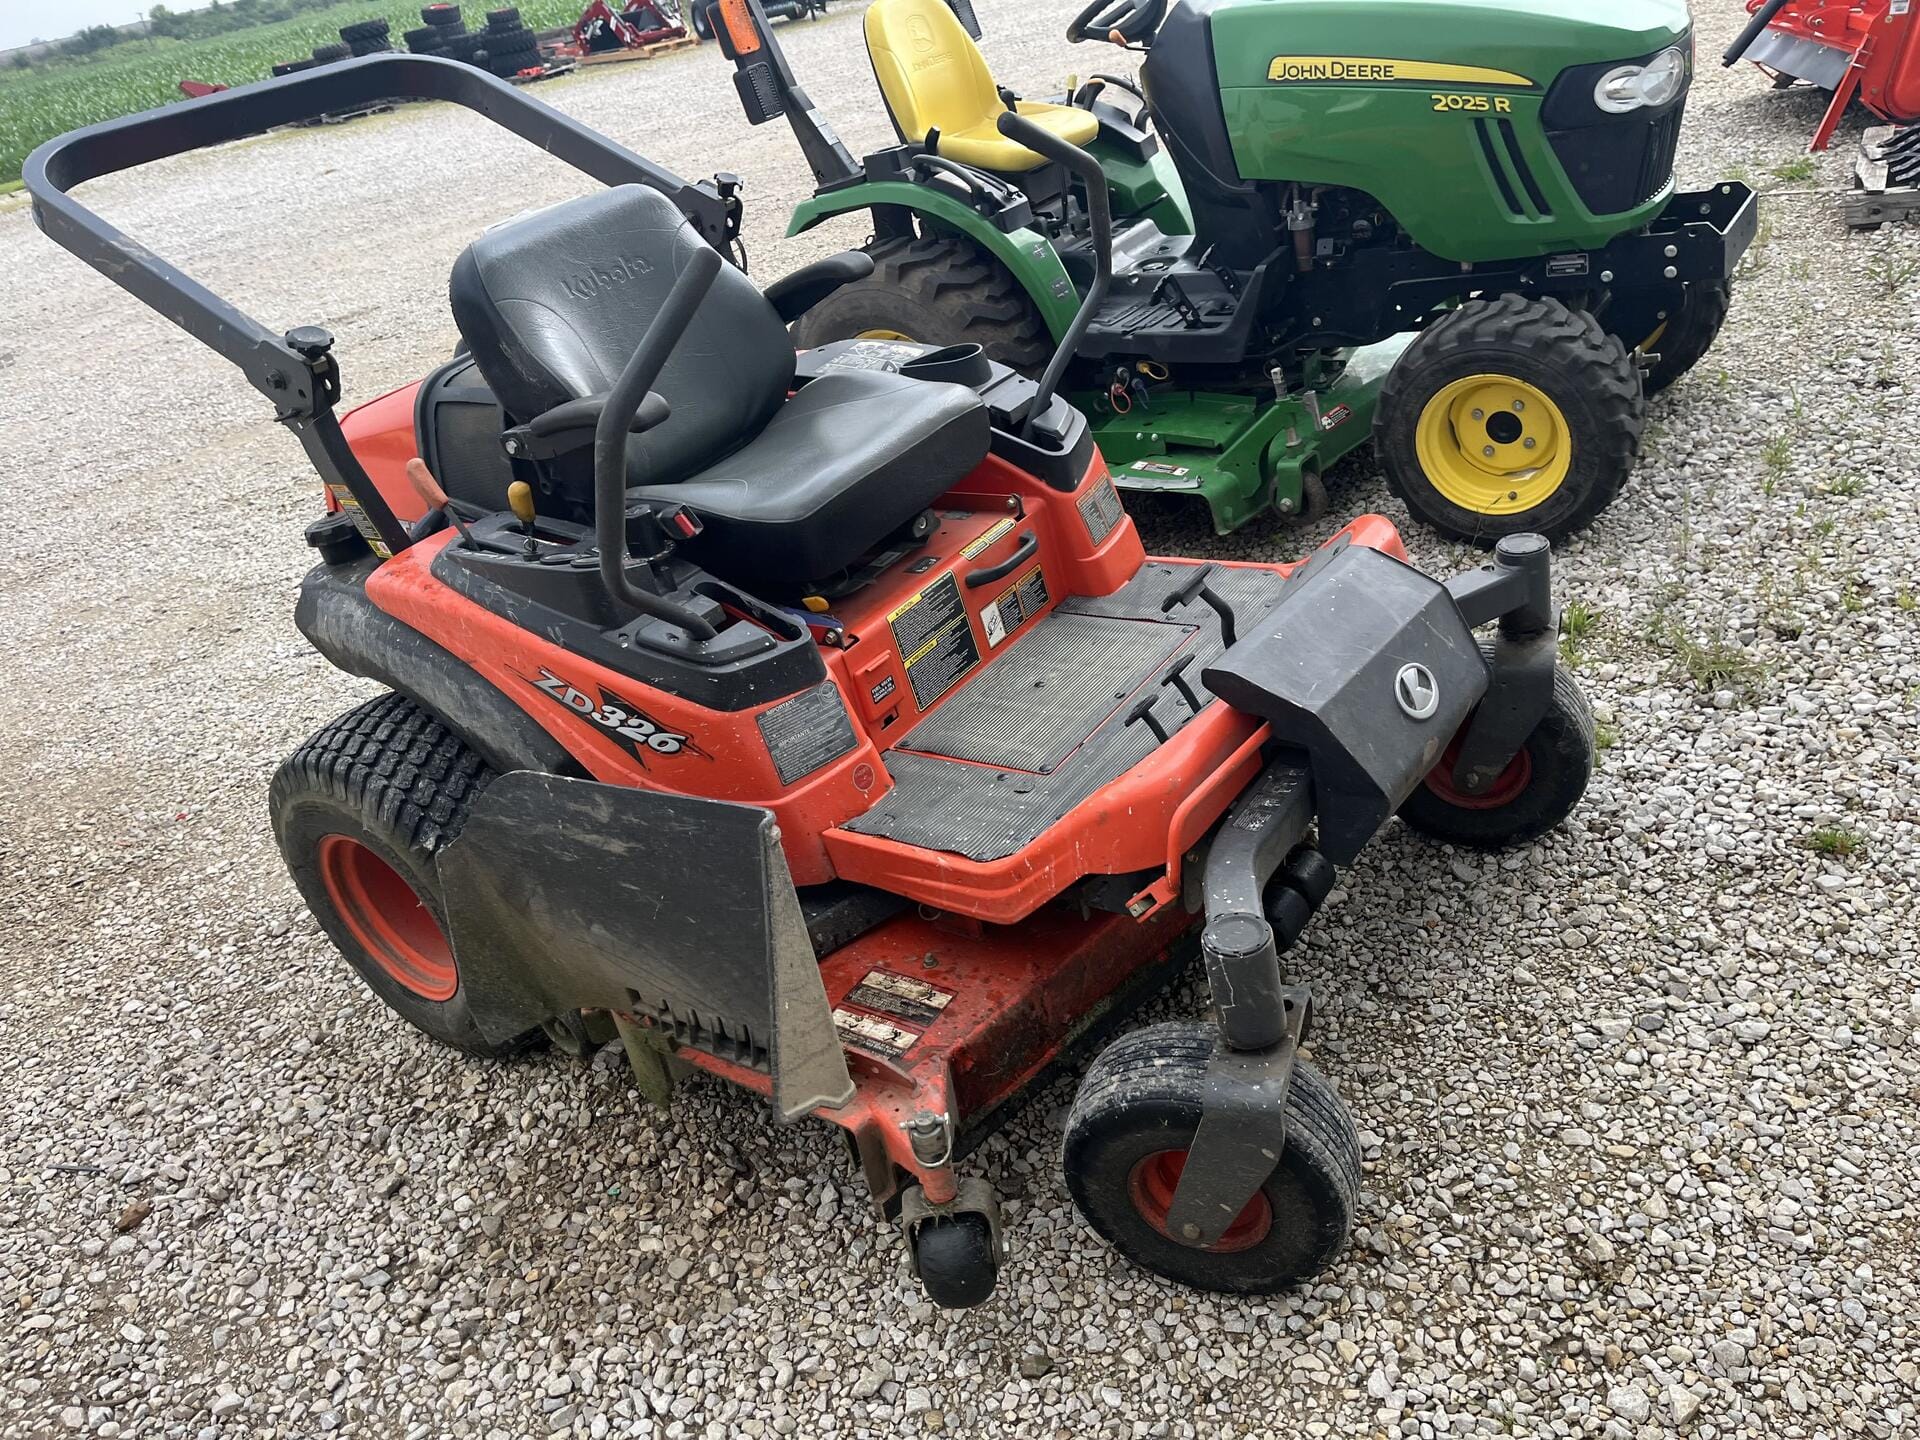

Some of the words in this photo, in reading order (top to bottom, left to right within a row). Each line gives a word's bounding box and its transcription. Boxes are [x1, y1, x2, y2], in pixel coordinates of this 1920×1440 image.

[1277, 62, 1327, 80] JOHN
[1330, 61, 1395, 79] DEERE
[1431, 94, 1490, 112] 2025
[1493, 97, 1512, 113] R
[560, 256, 655, 300] Kubota
[531, 668, 688, 754] ZD326
[765, 698, 797, 716] IMPORTANT
